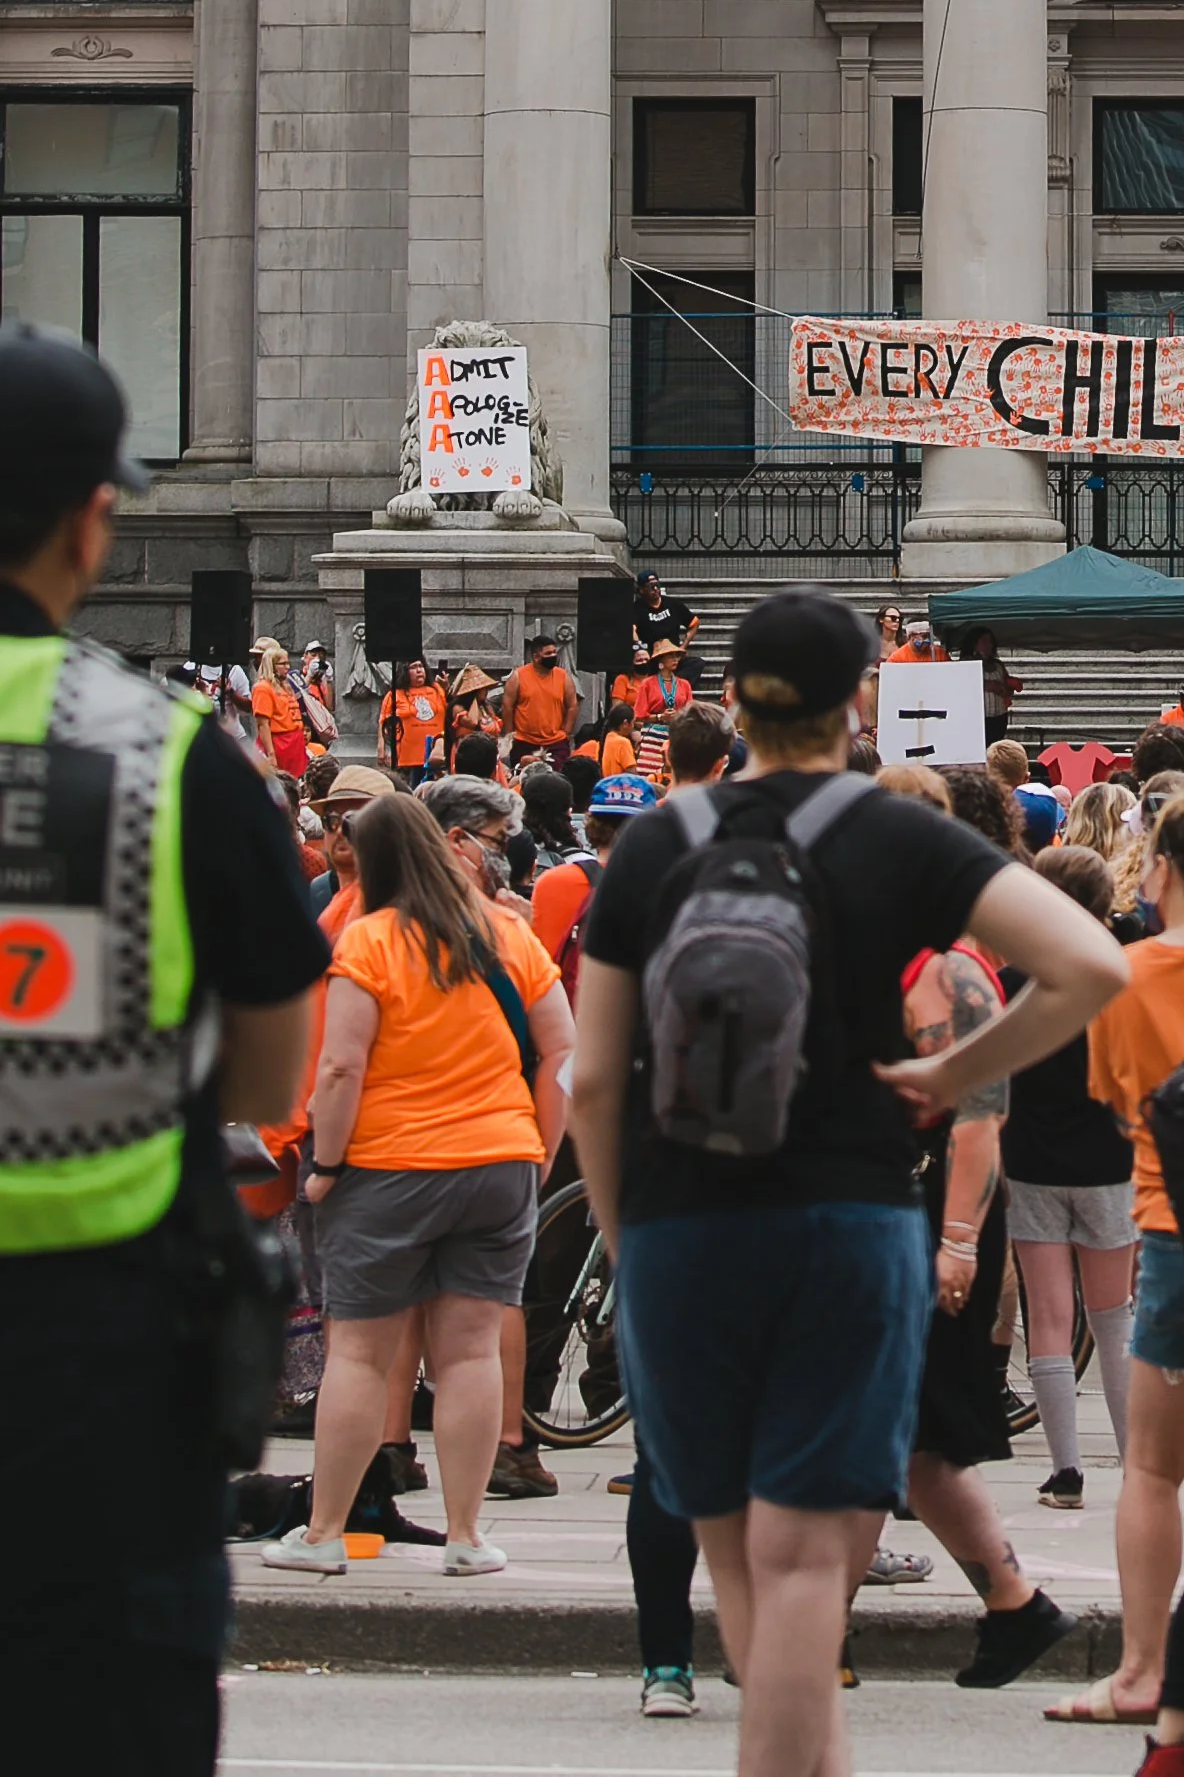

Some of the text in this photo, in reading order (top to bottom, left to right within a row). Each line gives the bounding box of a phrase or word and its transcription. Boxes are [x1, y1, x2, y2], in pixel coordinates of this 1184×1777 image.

[424, 355, 516, 387] ADMIT
[806, 340, 969, 400] EVERY
[427, 423, 507, 454] ATONE
[3, 943, 47, 1007] 7
